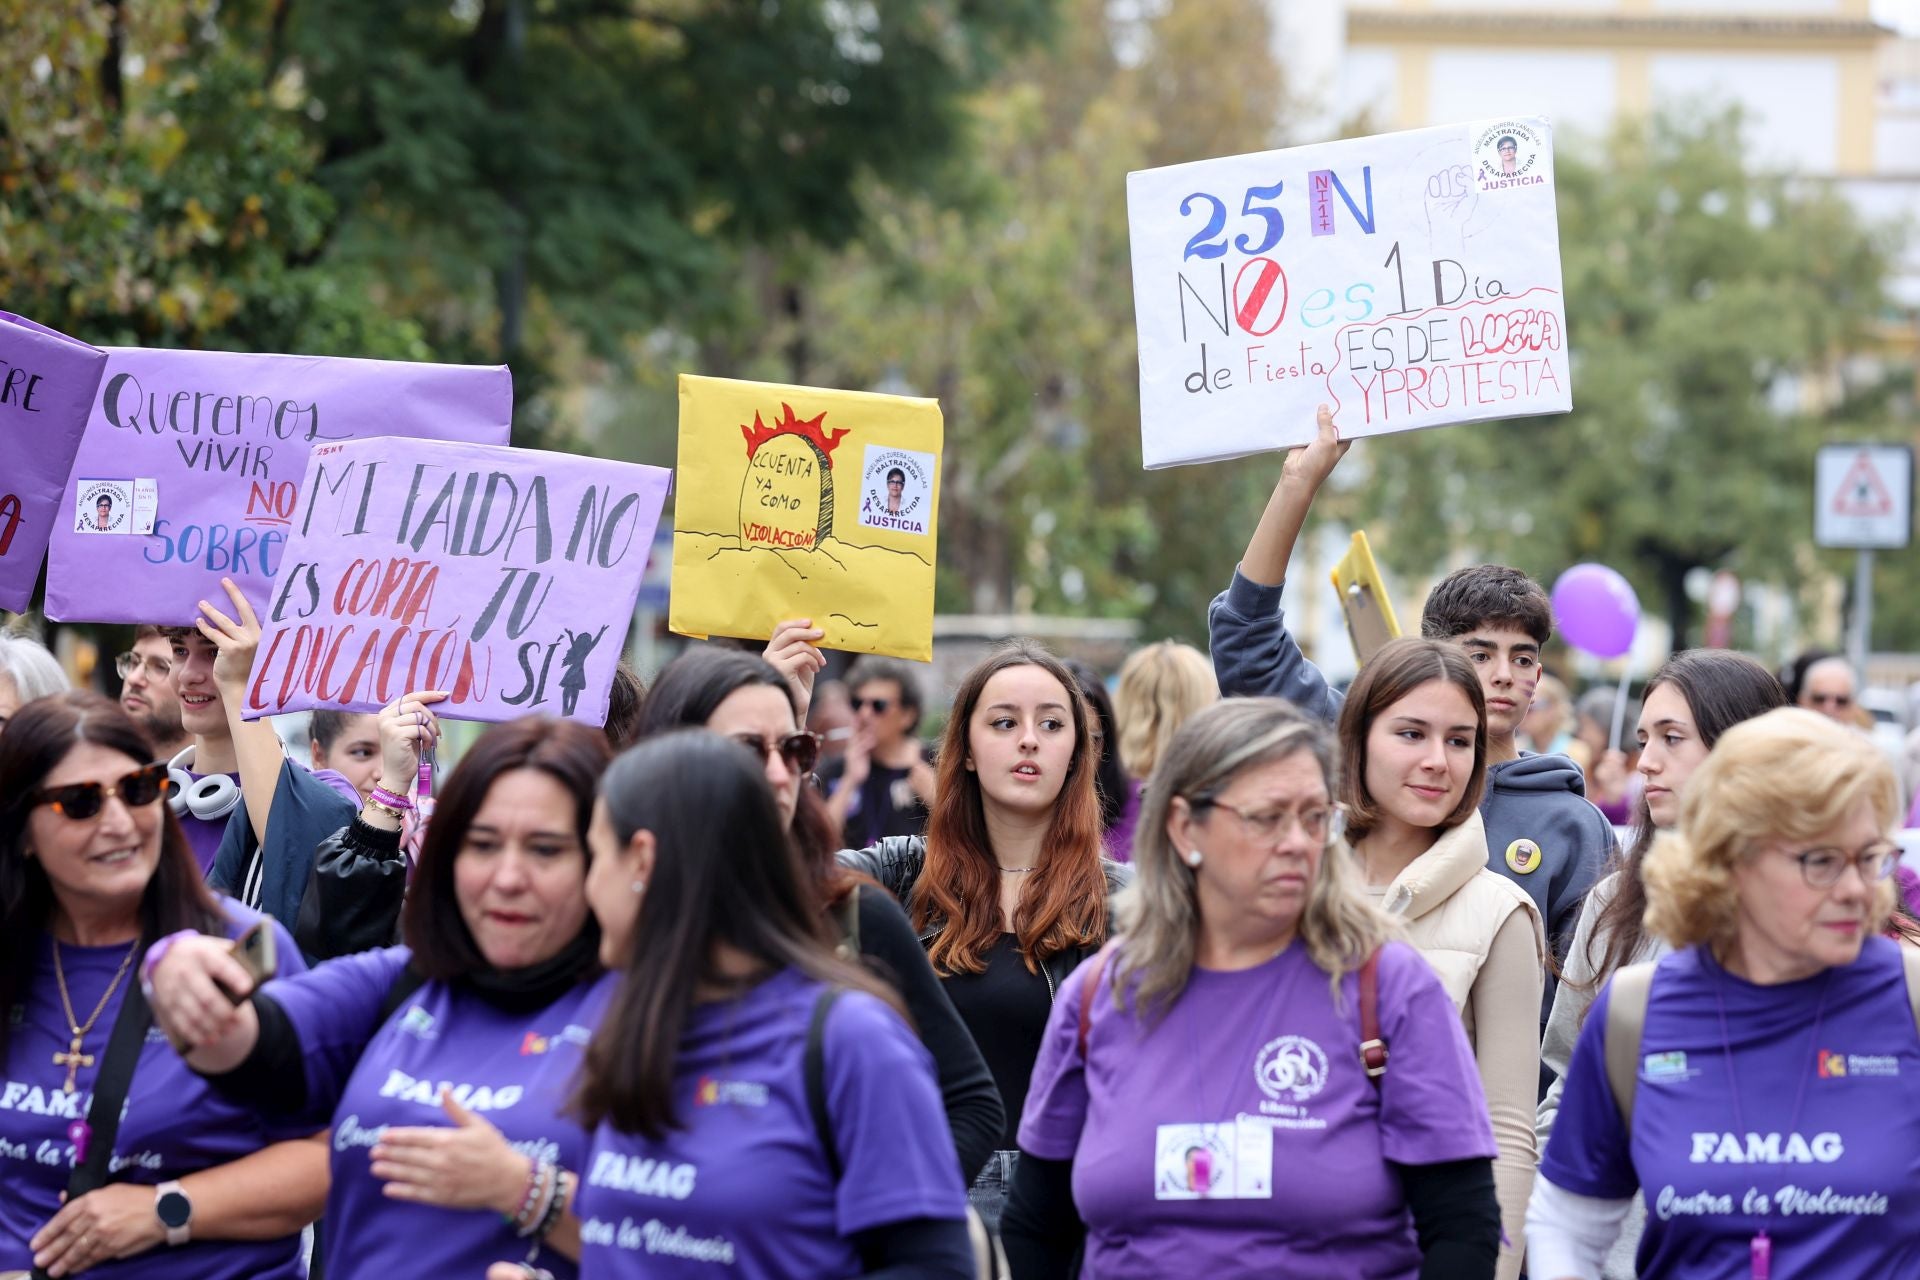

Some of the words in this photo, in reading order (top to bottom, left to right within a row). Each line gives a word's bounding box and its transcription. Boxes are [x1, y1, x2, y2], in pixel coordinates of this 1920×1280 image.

[1483, 128, 1530, 148] MALTRATADA
[1482, 153, 1537, 178] DESAPARECIDA
[1482, 175, 1544, 191] JUSTICIA
[1179, 180, 1285, 262] 25
[1330, 165, 1376, 235] N
[1178, 256, 1288, 342] NO
[1300, 282, 1375, 328] es
[1384, 240, 1423, 317] 1
[1432, 258, 1510, 307] Día
[1347, 327, 1395, 372] ES
[1406, 319, 1450, 364] DE
[1460, 308, 1560, 358] LUCHA
[1185, 342, 1233, 394] de
[1246, 340, 1328, 384] Fiesta
[103, 373, 354, 441] Queremos
[755, 476, 772, 492] YA
[875, 459, 918, 480] MALTRATADA
[87, 488, 123, 502] MALTRATADA
[246, 481, 297, 519] NO
[760, 494, 801, 510] COMO
[870, 489, 921, 517] DESAPARECIDA
[83, 512, 125, 532] DESAPARECIDA
[302, 460, 387, 539] MI
[397, 463, 553, 565] FALDA
[564, 484, 641, 568] NO
[865, 514, 922, 532] JUSTICIA
[271, 563, 321, 622] ES
[333, 557, 440, 627] CORTA
[470, 566, 554, 642] TU
[249, 614, 492, 712] EDUCACIÓN
[500, 634, 566, 708] SÍ
[35, 1138, 61, 1166] la
[1690, 1132, 1844, 1163] FAMAG
[1656, 1184, 1734, 1221] Contra
[1742, 1186, 1771, 1216] la
[1774, 1184, 1889, 1217] Violencia
